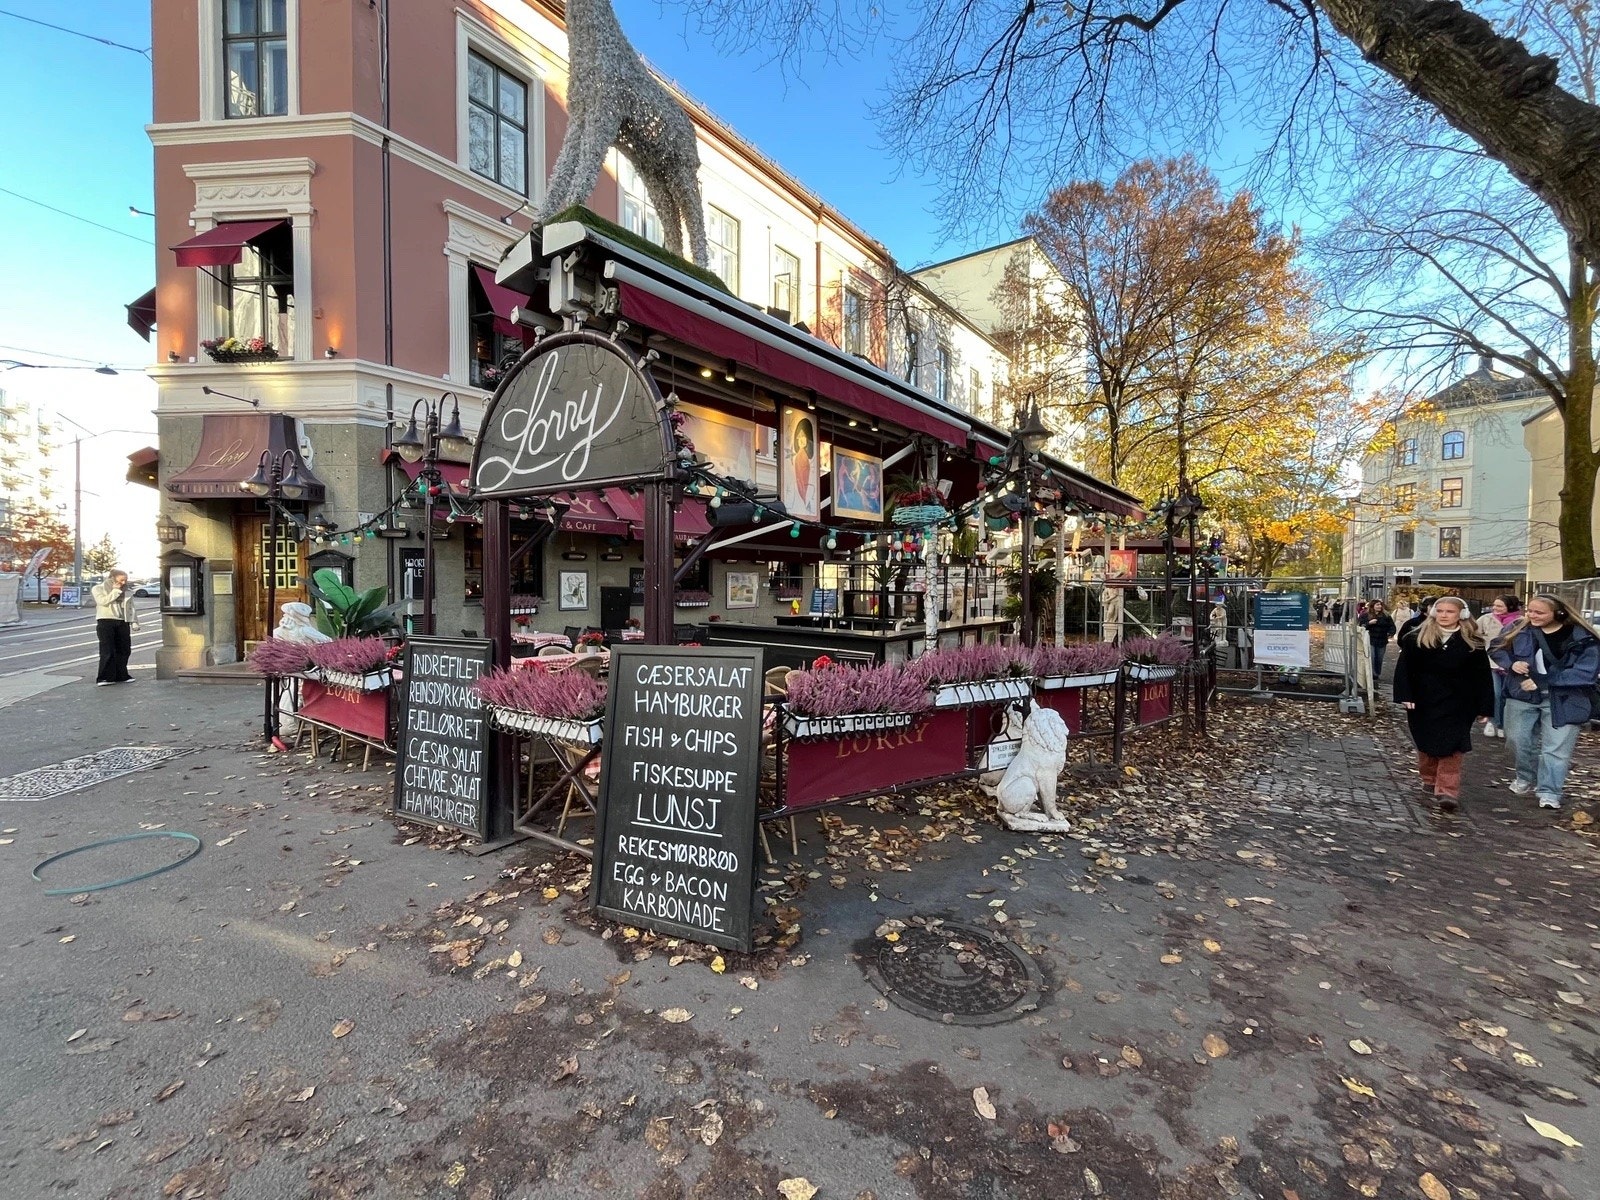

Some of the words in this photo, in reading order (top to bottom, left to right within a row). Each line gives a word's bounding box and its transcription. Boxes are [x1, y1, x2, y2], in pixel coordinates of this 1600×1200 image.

[476, 350, 631, 493] Lorry
[413, 654, 484, 681] INDREFILET
[636, 664, 753, 689] CÆSERSALAT
[634, 690, 743, 720] HAMBURGER
[407, 709, 483, 741] FJELLØRRET
[625, 725, 663, 748] FISH
[684, 728, 738, 756] CHIPS
[409, 737, 450, 767] CÆSAR
[451, 746, 483, 774] SALAT
[403, 764, 449, 793] CHEVRE
[449, 773, 482, 801] SALAT
[633, 761, 738, 793] FISKESUPPE
[405, 791, 477, 828] HAMBURGER
[636, 793, 722, 830] LUNSJ
[618, 834, 739, 873] REKESMØRBRØD
[613, 861, 645, 886] EGG
[665, 870, 728, 902] BACON
[623, 887, 726, 933] KARBONADE
